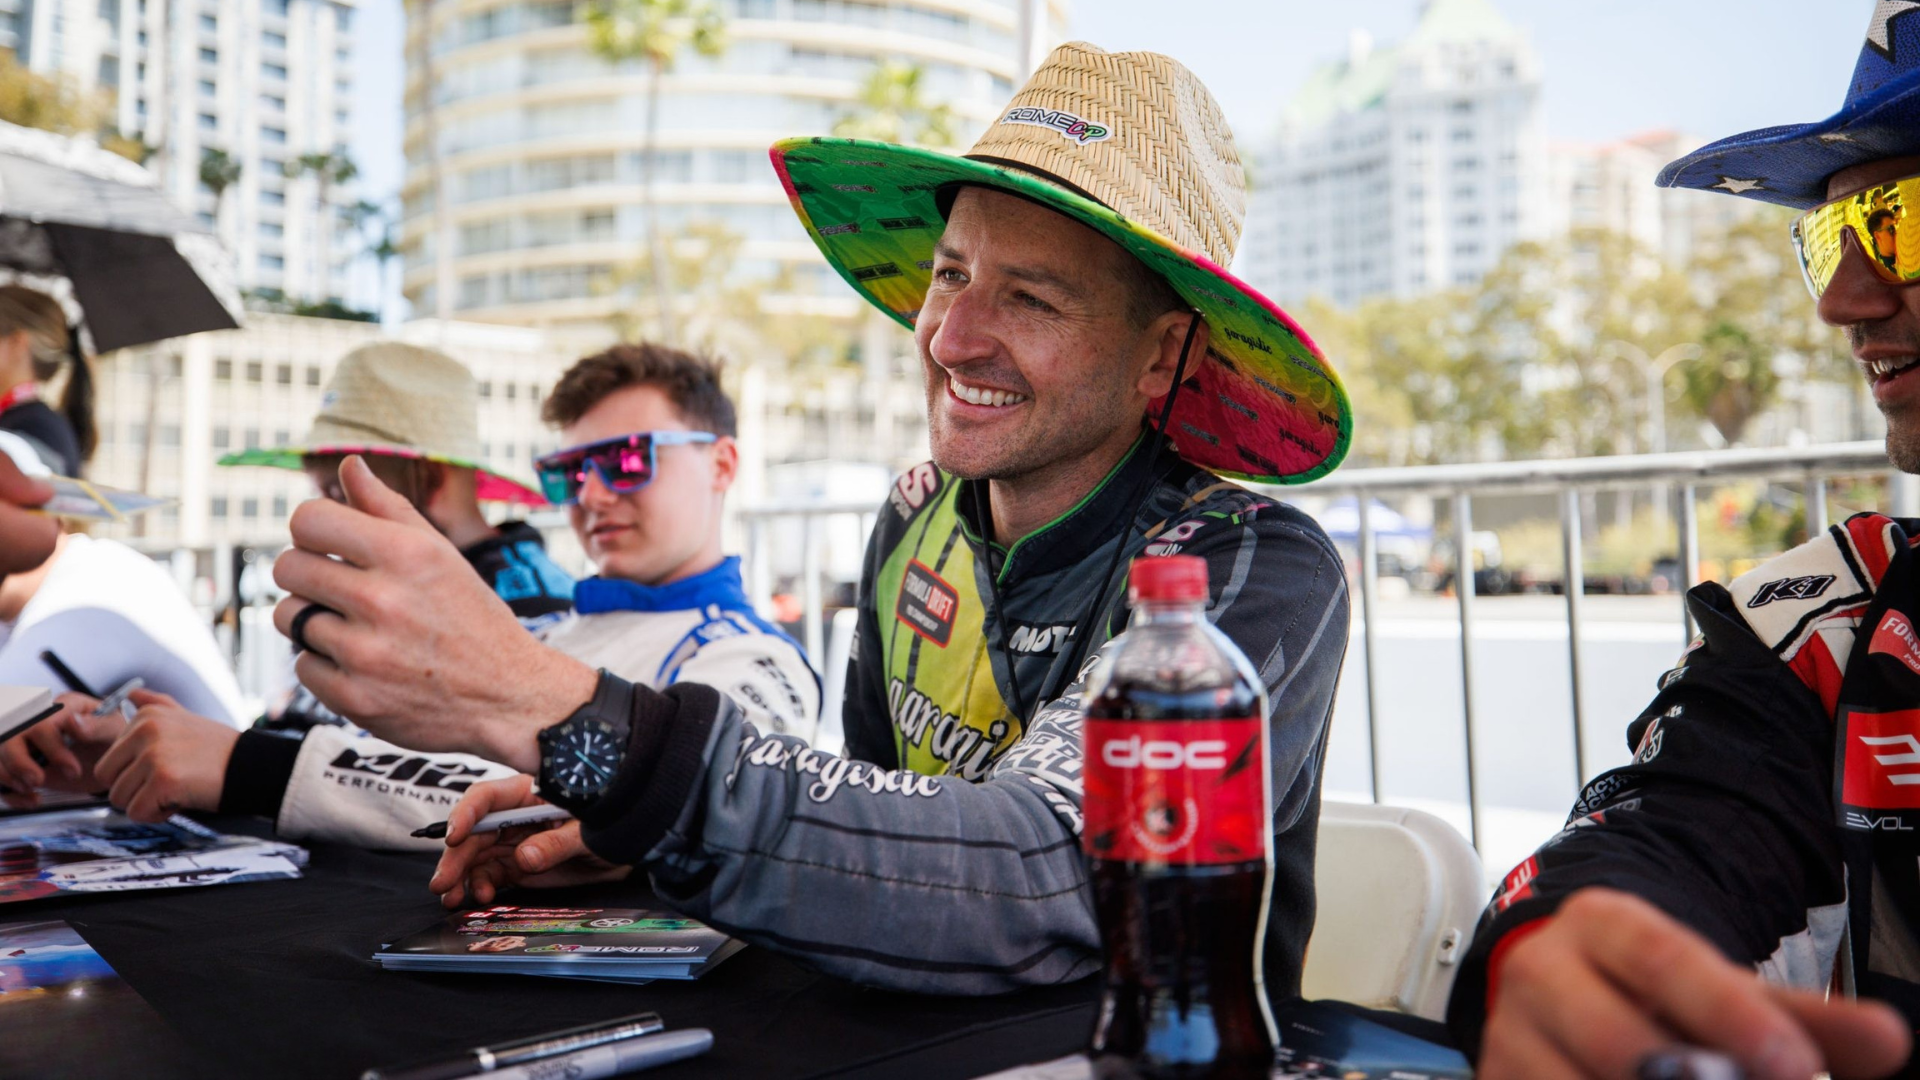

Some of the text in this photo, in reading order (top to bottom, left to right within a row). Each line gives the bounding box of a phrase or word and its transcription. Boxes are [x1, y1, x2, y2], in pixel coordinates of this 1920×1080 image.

[1747, 574, 1838, 609] K1
[725, 735, 942, 803] garagistic
[1102, 734, 1228, 770] doc
[323, 770, 462, 807] PERFORMAN
[1845, 811, 1915, 831] EVOL
